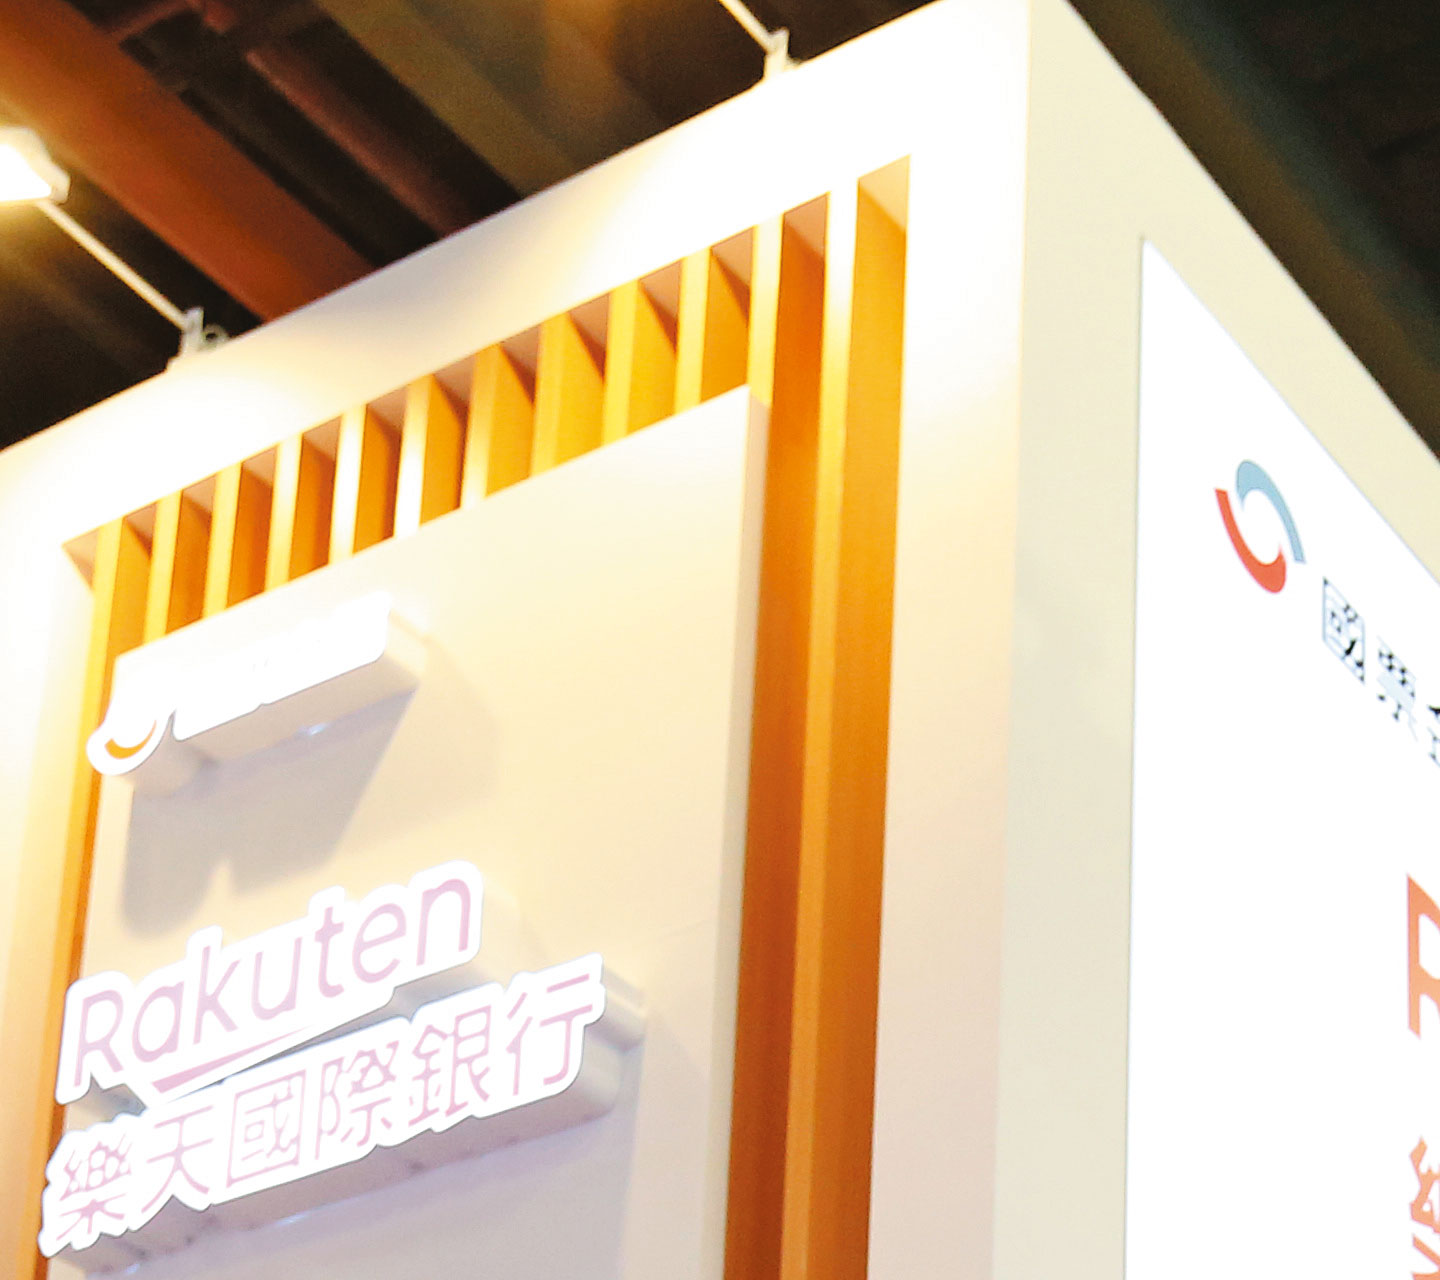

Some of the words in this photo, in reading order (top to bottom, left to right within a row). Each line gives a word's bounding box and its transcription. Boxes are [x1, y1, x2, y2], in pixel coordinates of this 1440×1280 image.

[72, 877, 472, 1088] Rakuten
[55, 972, 595, 1241] 樂天國際銀行
